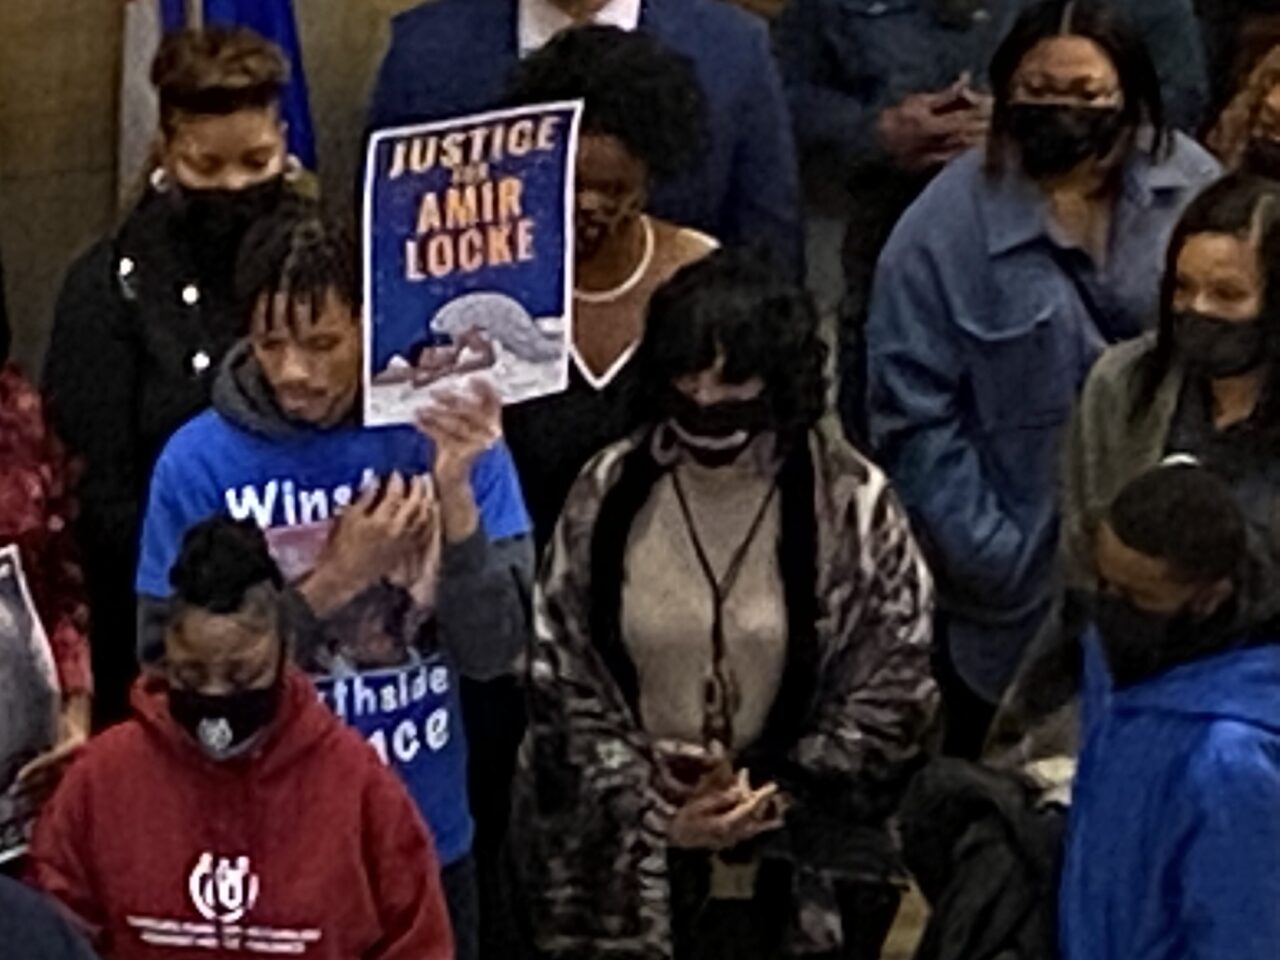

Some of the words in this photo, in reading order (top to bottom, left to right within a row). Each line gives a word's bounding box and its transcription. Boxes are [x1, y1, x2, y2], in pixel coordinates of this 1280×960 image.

[389, 116, 561, 179] JUSTICE
[416, 176, 523, 233] AMIR
[405, 220, 536, 281] LOCKE
[316, 666, 448, 717] thside
